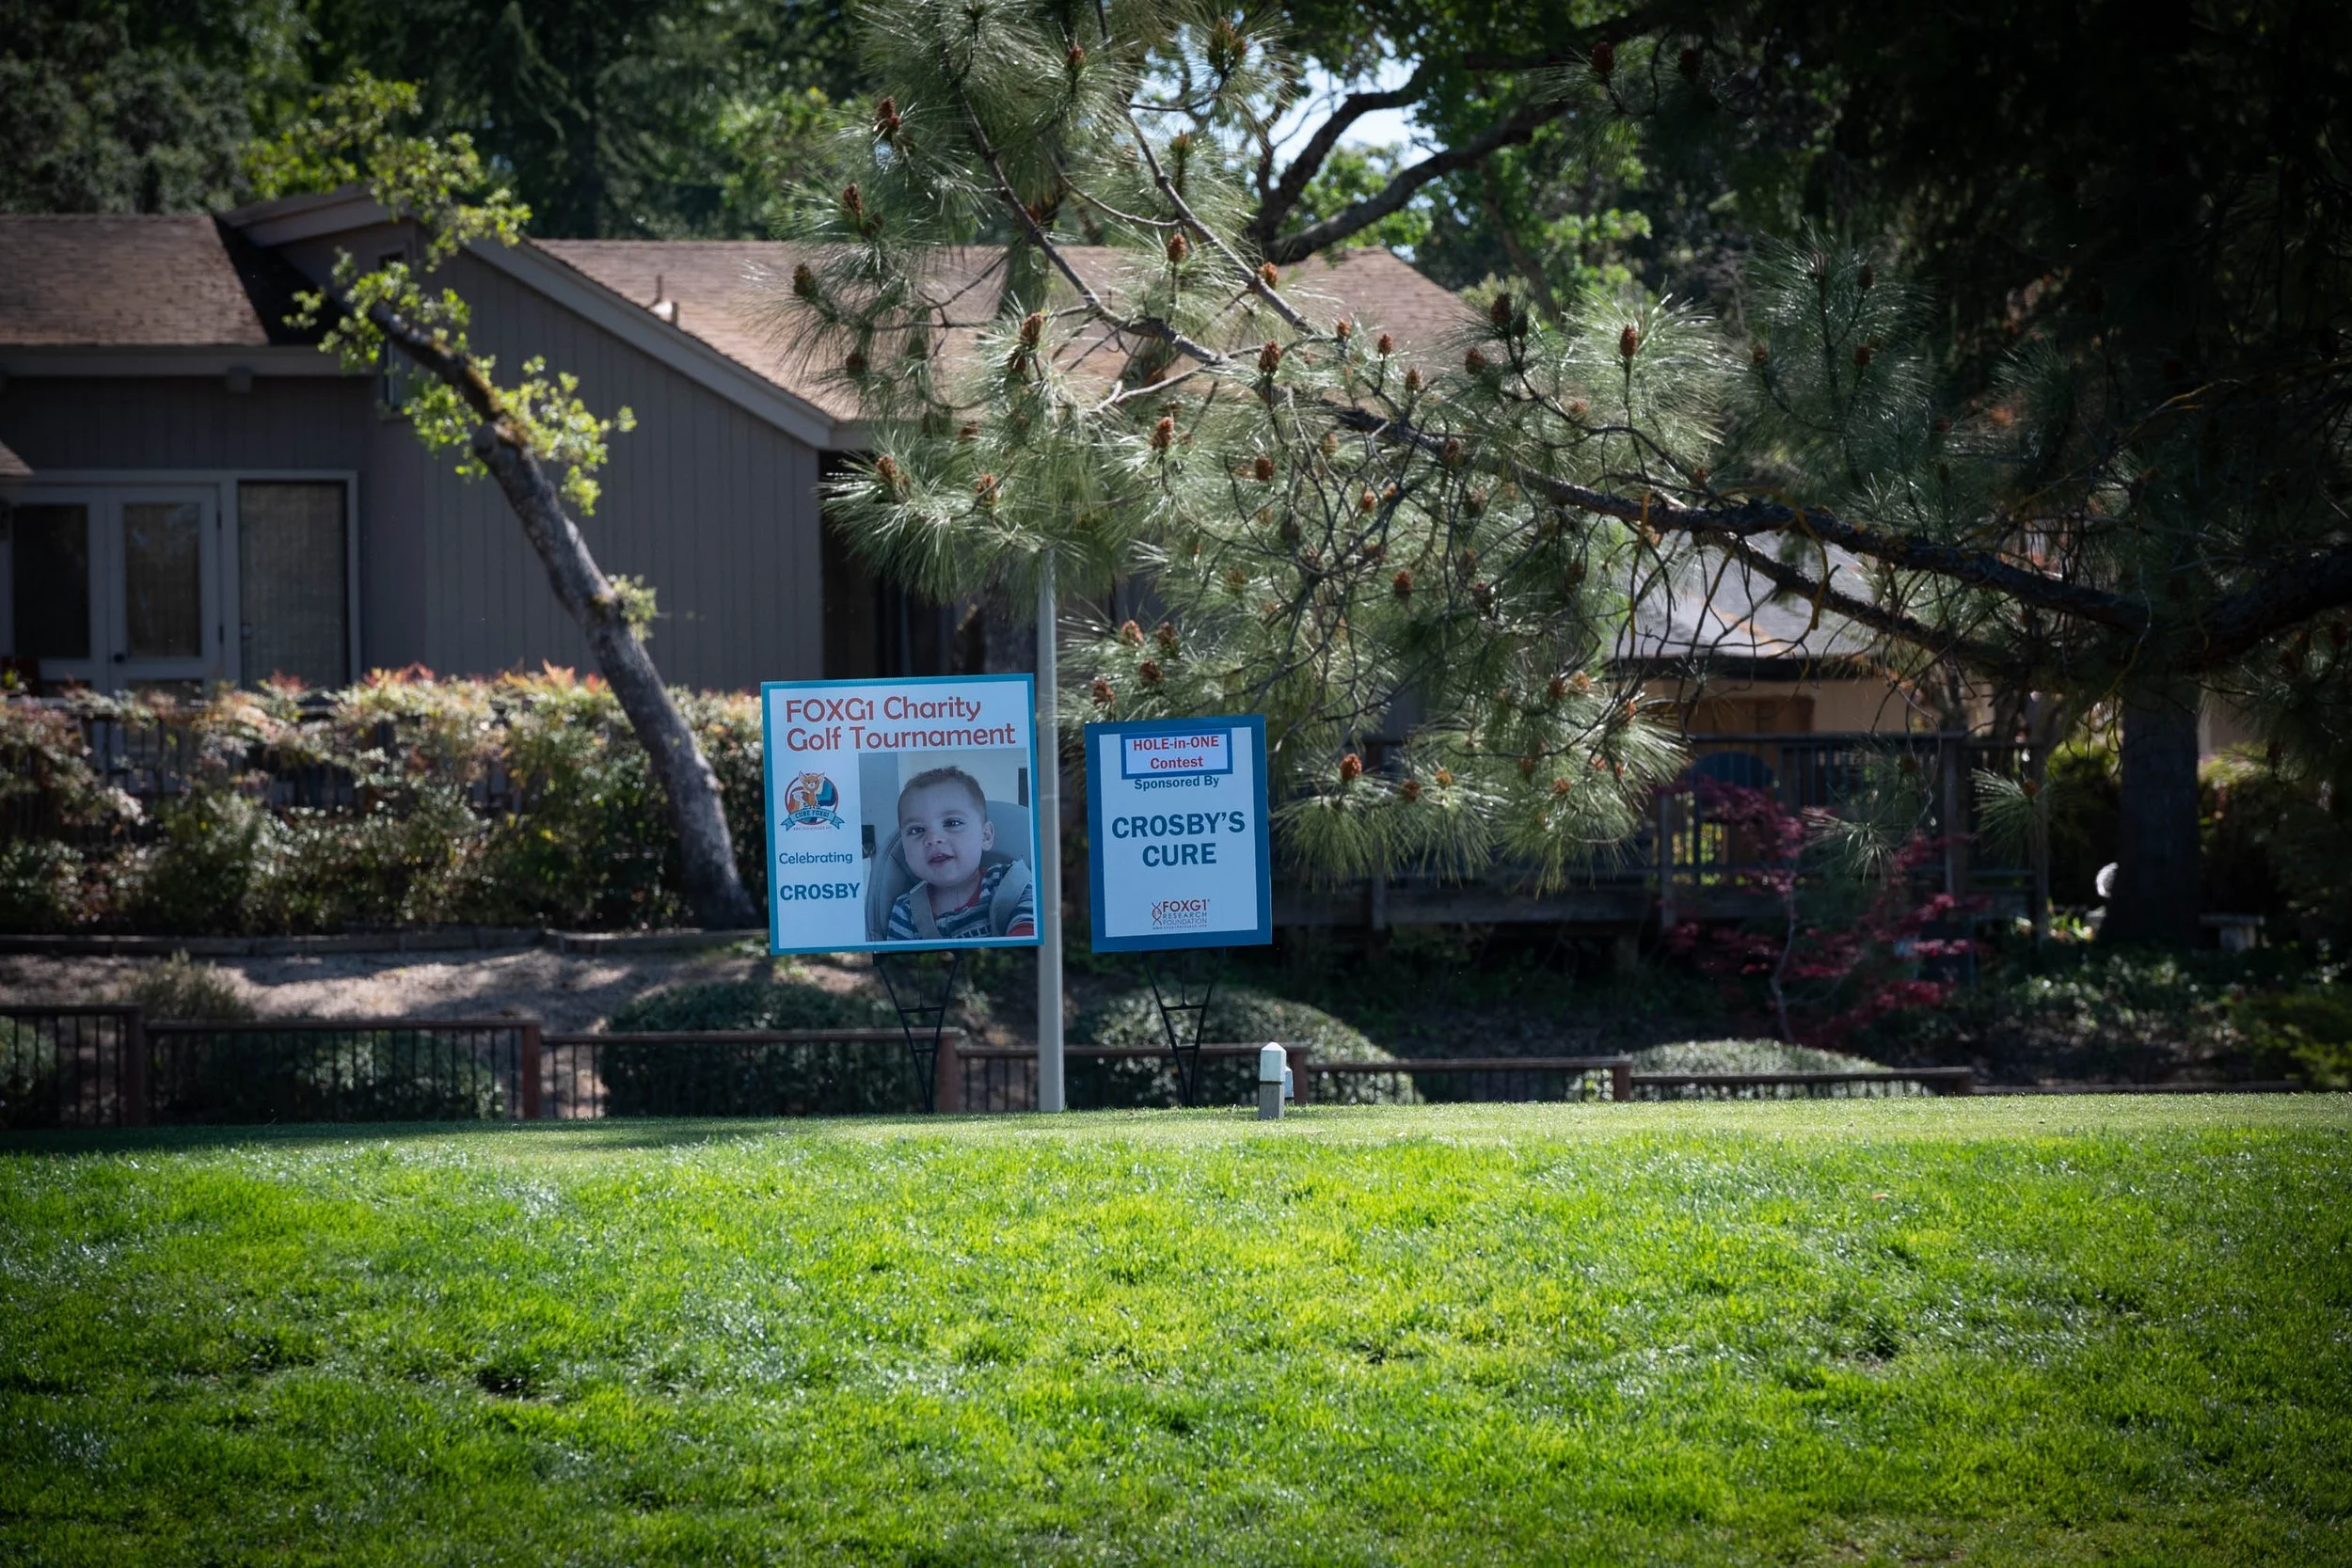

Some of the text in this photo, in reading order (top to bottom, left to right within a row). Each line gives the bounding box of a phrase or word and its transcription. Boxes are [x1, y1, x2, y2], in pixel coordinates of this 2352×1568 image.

[786, 696, 981, 722] FOXG1 Charity
[787, 723, 1016, 752] Golf Tournament
[1133, 736, 1219, 752] HOLE-in-ONE
[1150, 755, 1204, 769] Contest
[1134, 775, 1219, 791] Sponsored By
[1112, 811, 1246, 839] CROSBY'S
[779, 851, 853, 864] Celebrating
[1142, 843, 1217, 867] CURE
[780, 882, 861, 901] CROSBY
[1162, 899, 1207, 912] FOXG1
